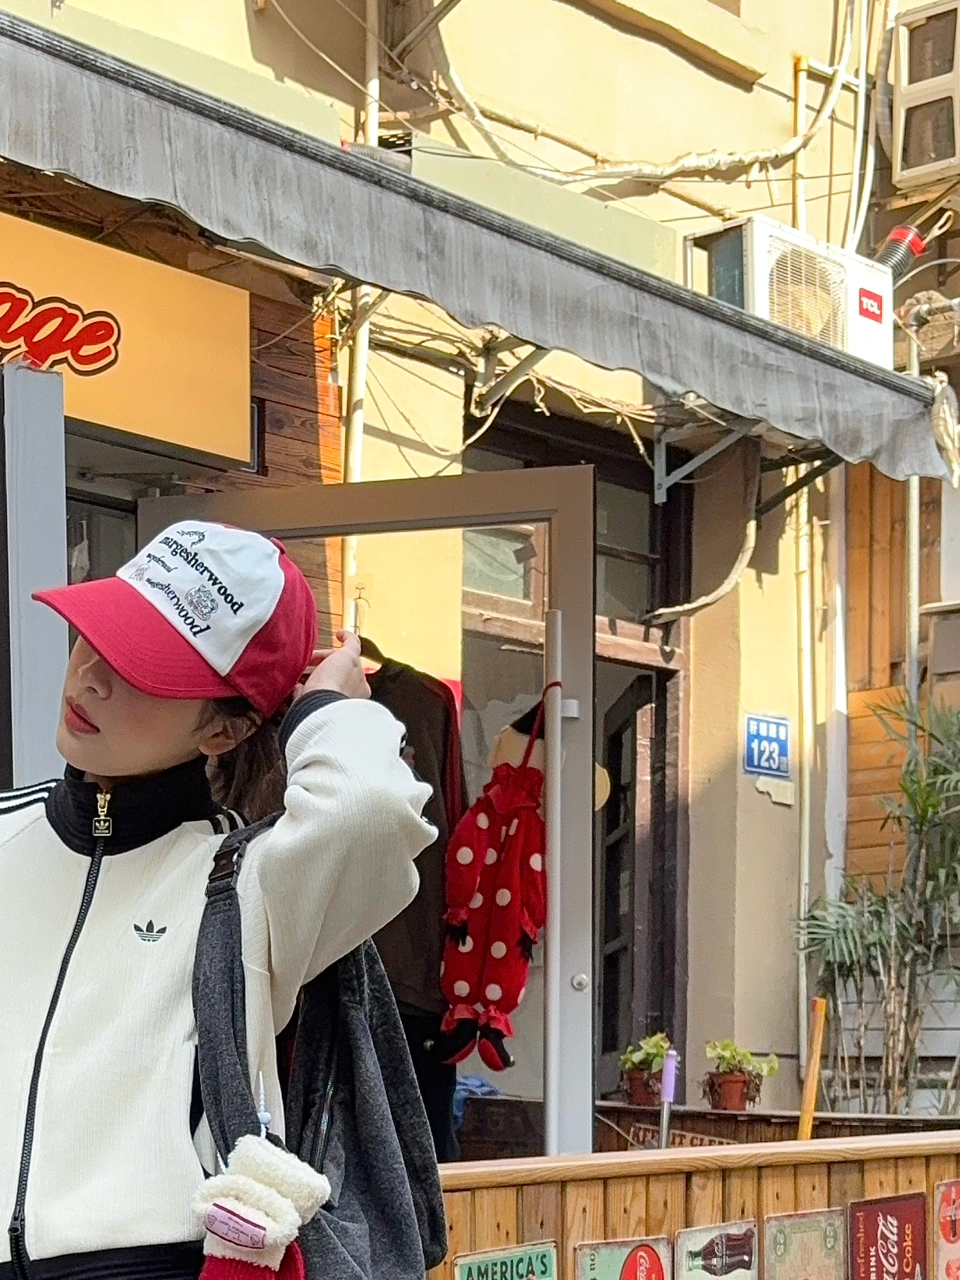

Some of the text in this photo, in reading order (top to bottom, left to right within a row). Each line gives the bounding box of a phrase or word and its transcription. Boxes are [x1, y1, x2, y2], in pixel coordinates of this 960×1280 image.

[861, 297, 880, 315] TCL
[751, 739, 779, 769] 123
[903, 1223, 913, 1273] Coke
